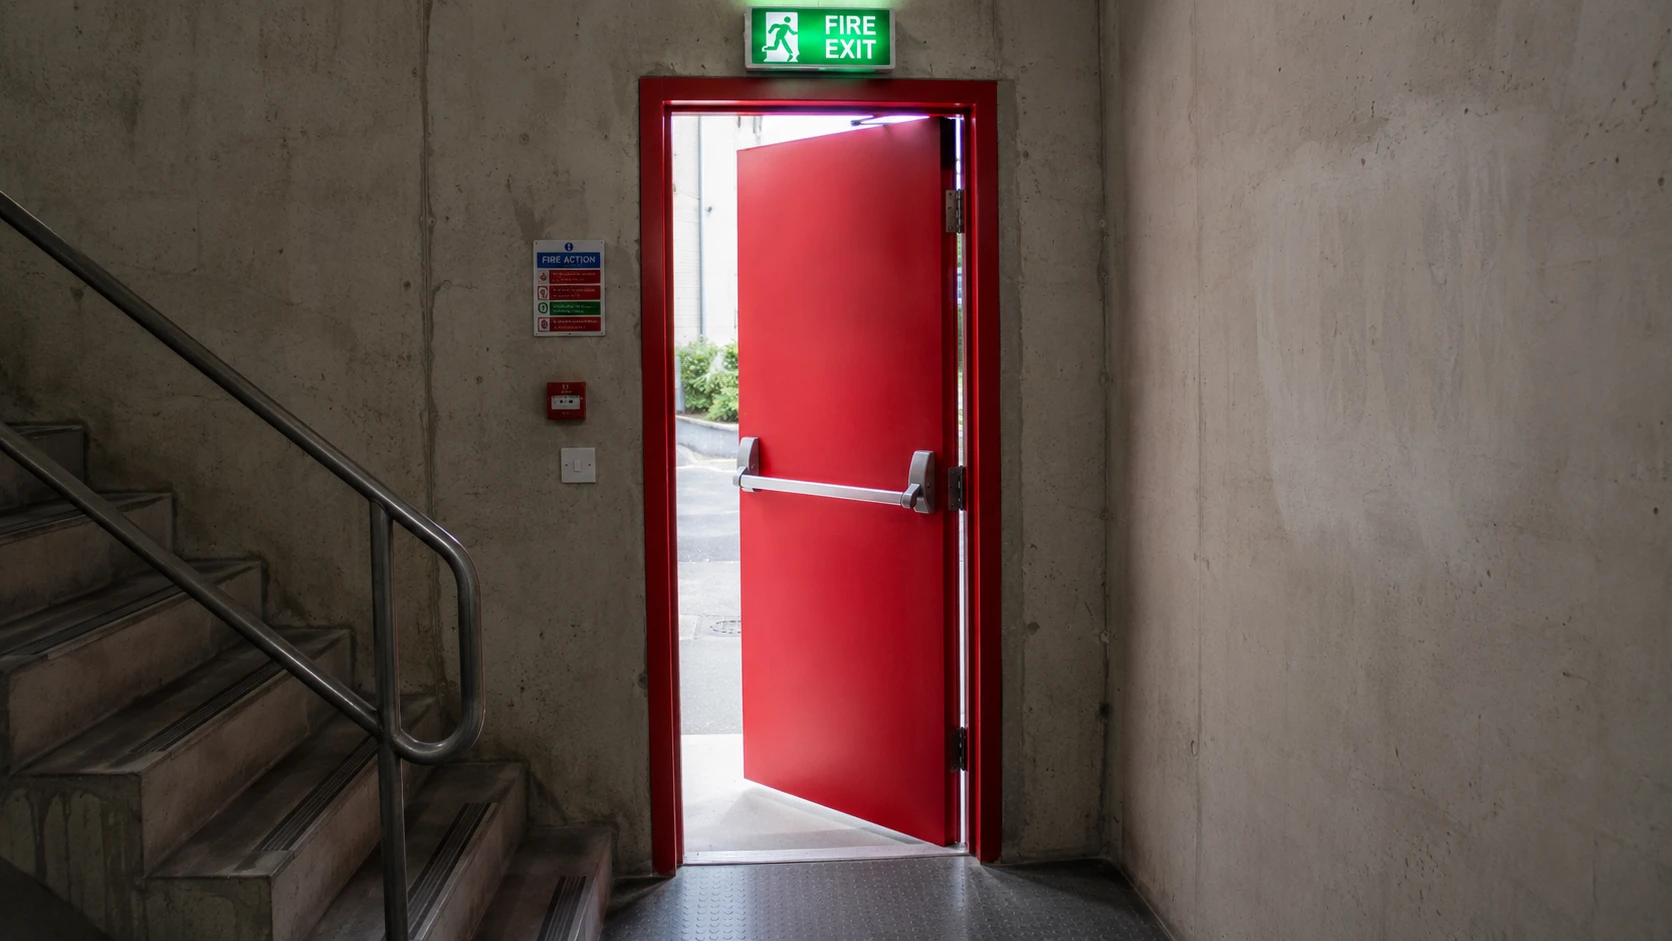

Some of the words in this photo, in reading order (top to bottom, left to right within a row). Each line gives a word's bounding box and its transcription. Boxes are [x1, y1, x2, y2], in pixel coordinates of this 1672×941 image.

[825, 15, 876, 35] FIRE
[825, 39, 876, 59] EXIT
[542, 255, 561, 264] FIRE
[563, 255, 596, 264] ACTION
